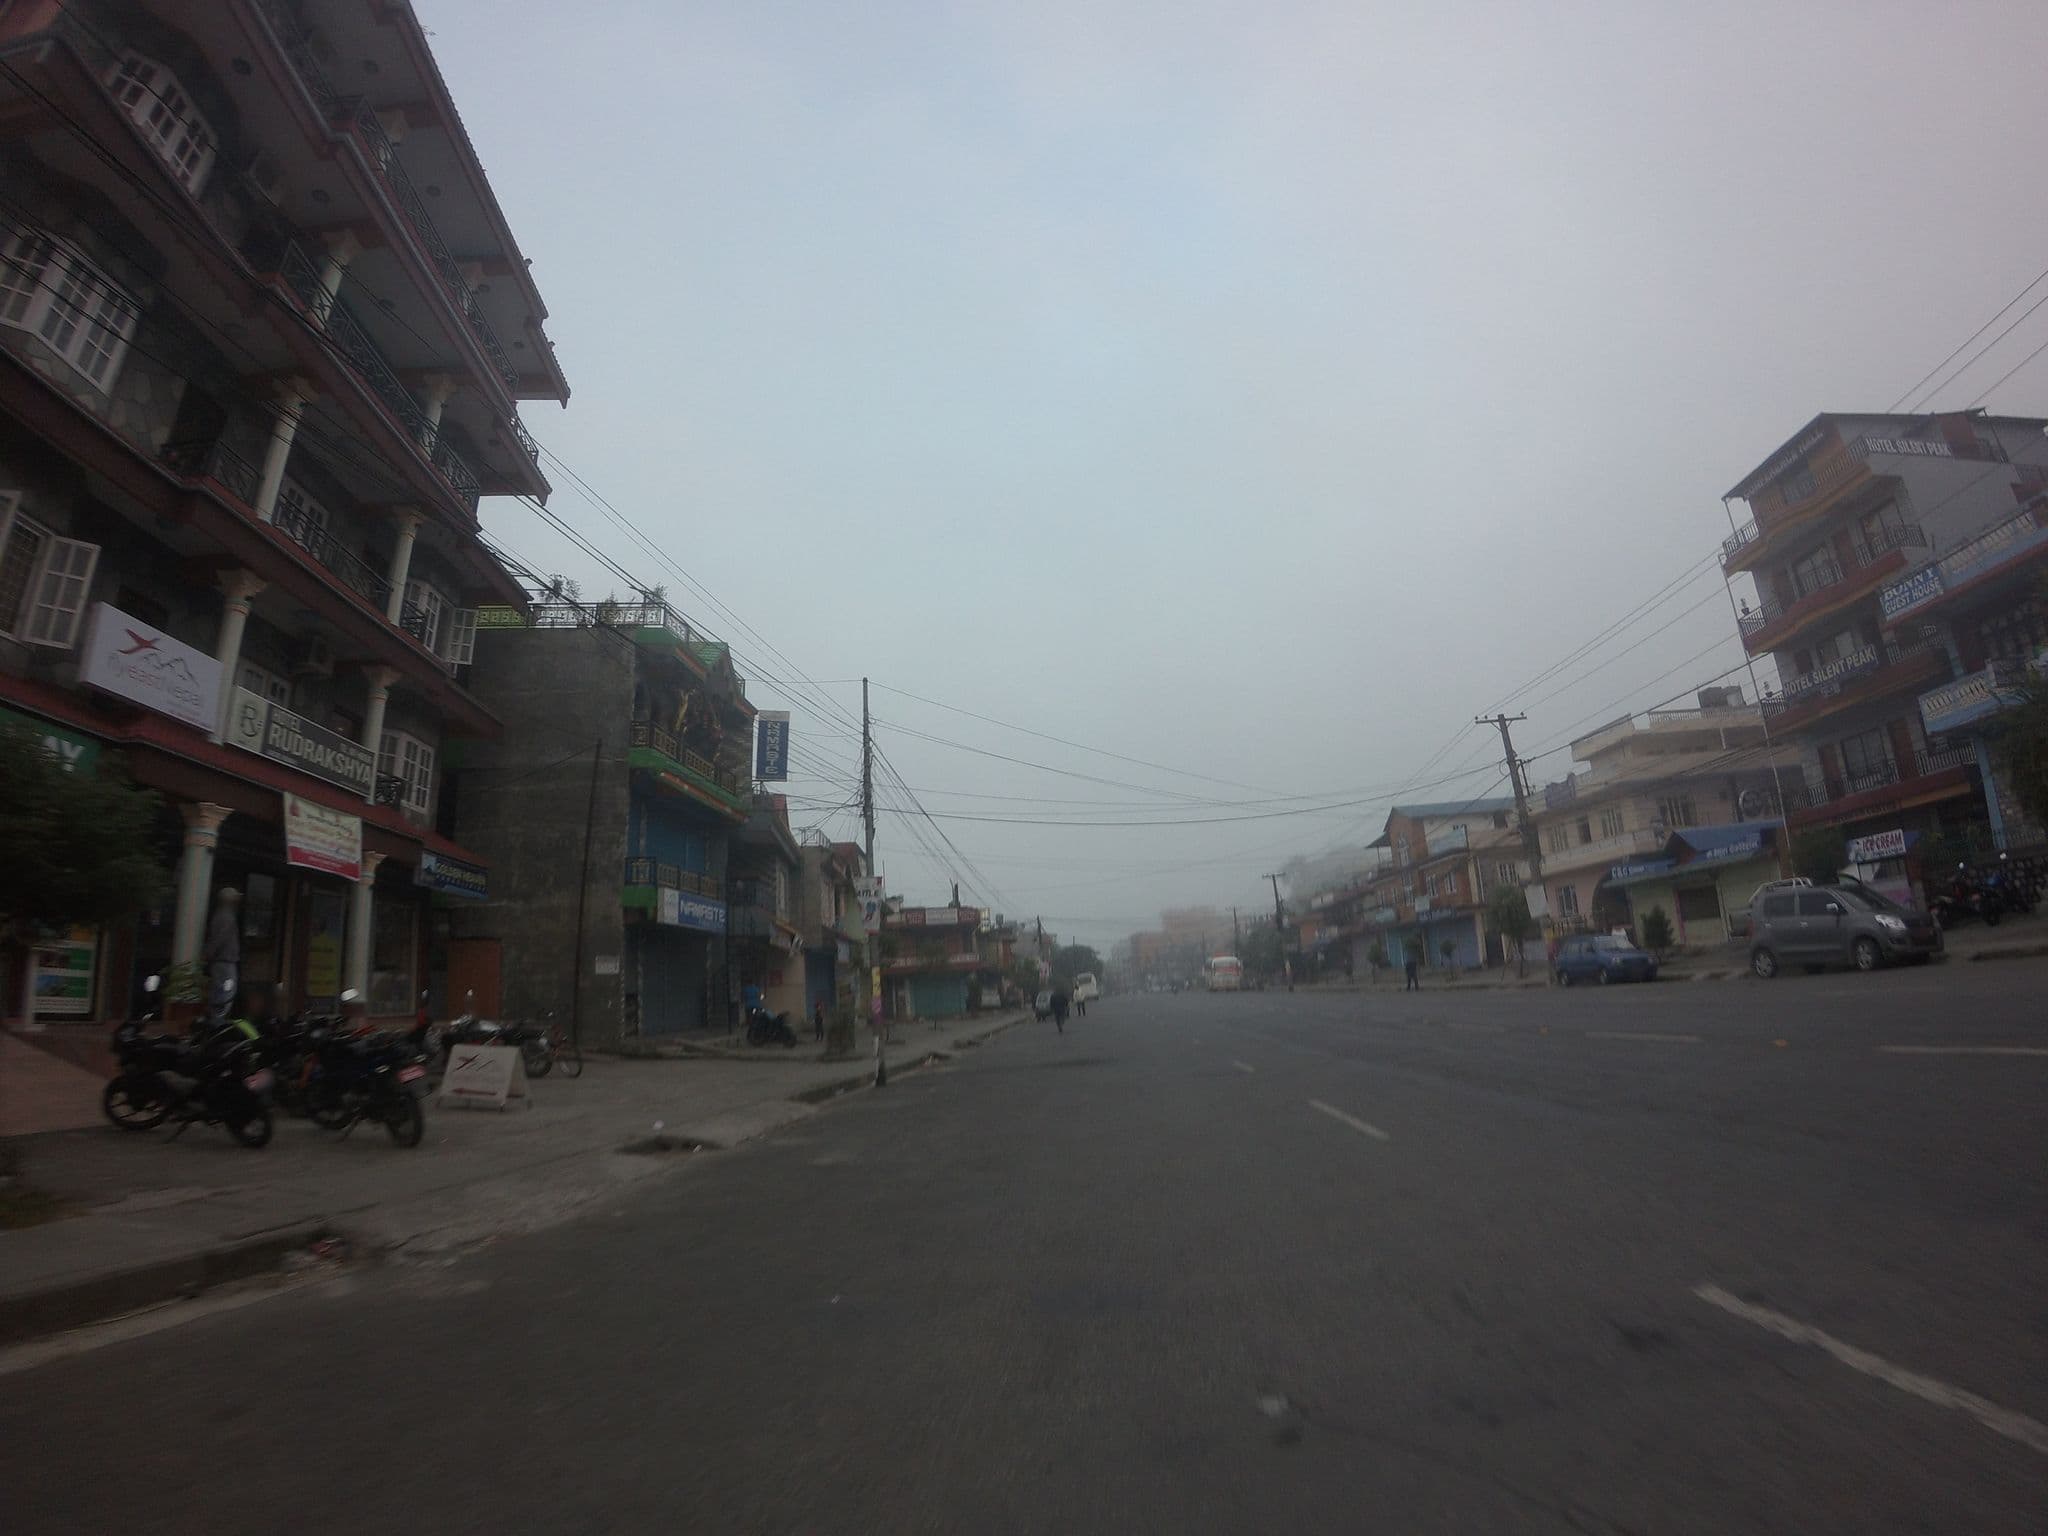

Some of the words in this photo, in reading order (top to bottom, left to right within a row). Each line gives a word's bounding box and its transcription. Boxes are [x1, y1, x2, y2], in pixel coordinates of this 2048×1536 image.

[1865, 436, 1896, 454] HOTEL
[1884, 591, 1911, 614] GUEST
[1911, 576, 1940, 601] HOUSE
[1783, 674, 1814, 697] HOTEL
[1812, 660, 1846, 685] SILENT
[1844, 646, 1876, 671] PEAK
[268, 723, 373, 785] RUDRAKSHYA
[1874, 832, 1904, 850] CREAM
